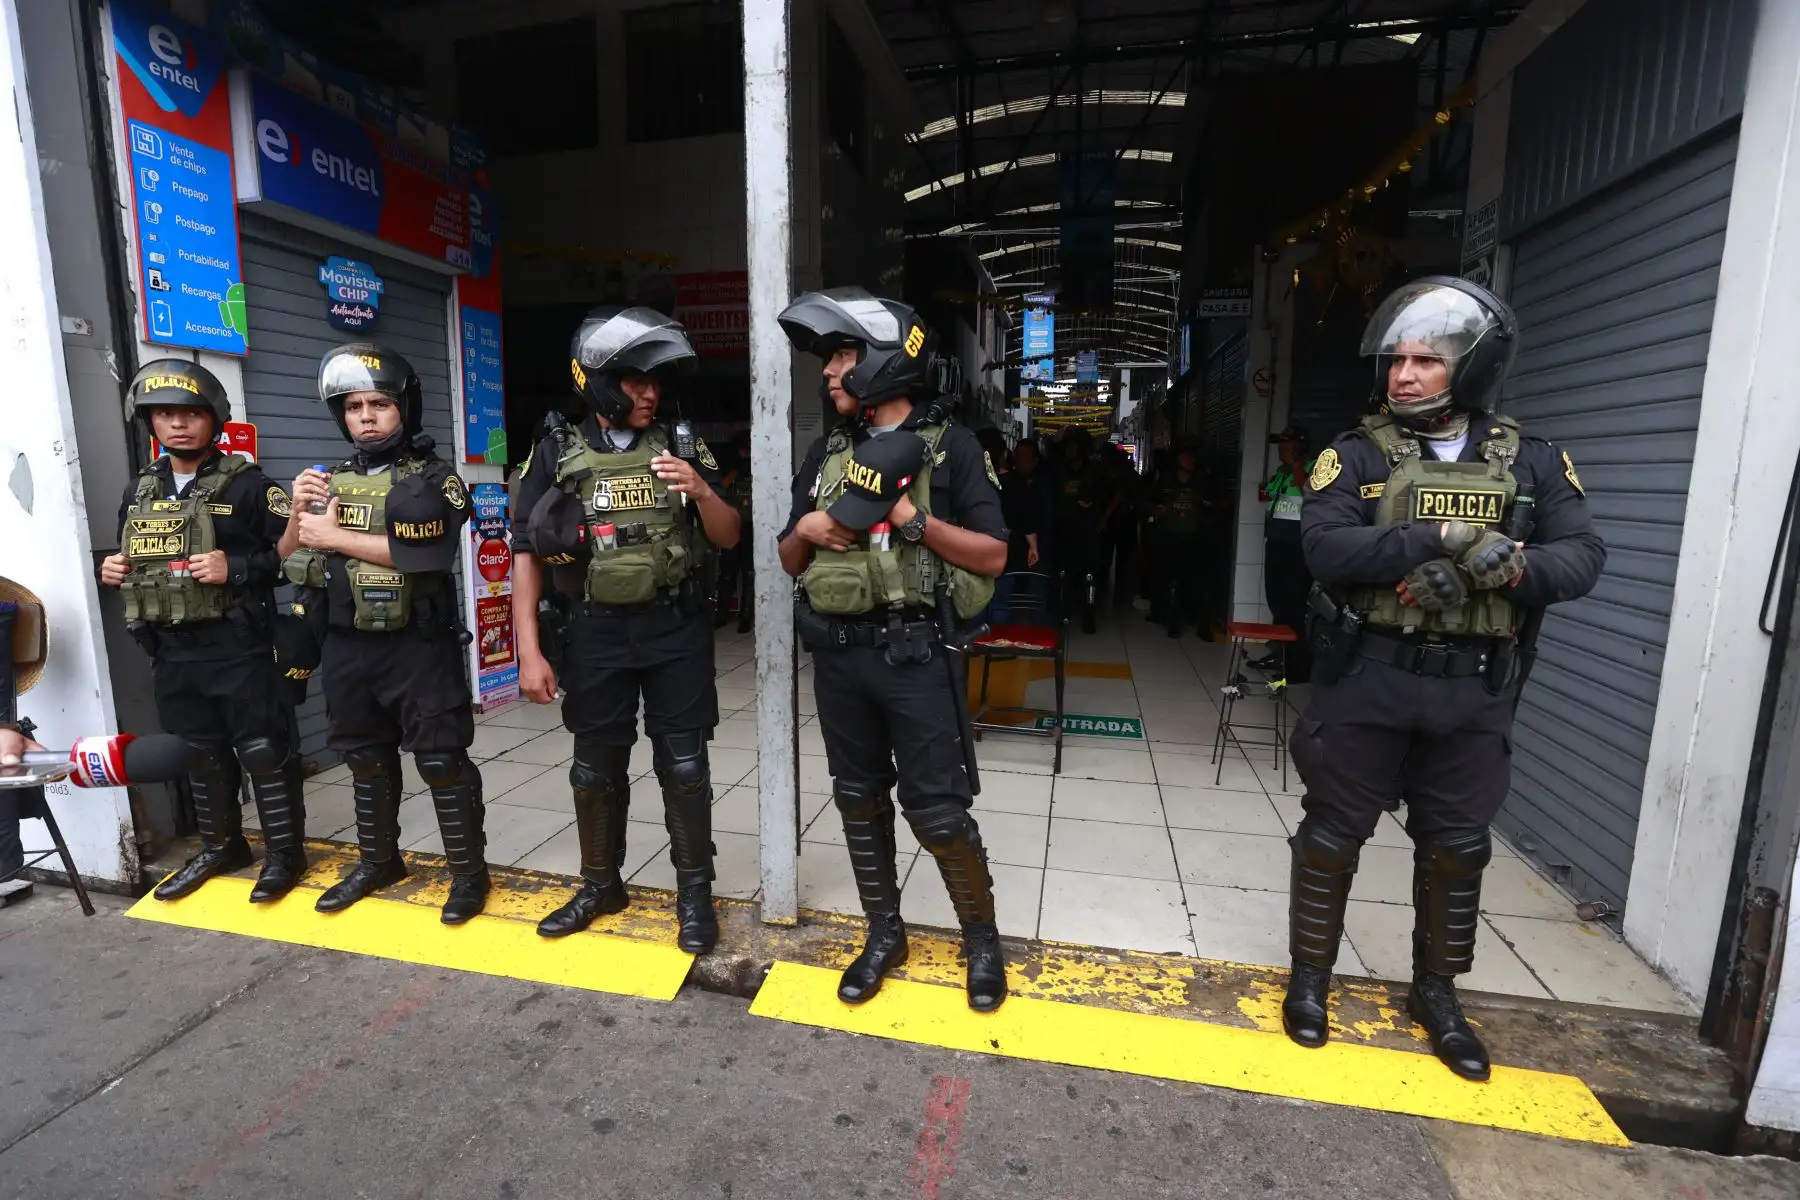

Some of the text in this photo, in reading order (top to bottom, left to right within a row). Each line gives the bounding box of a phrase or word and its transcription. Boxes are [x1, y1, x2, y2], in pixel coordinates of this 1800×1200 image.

[149, 61, 201, 93] entel
[169, 141, 194, 159] Venta
[170, 155, 207, 175] de chips
[312, 148, 379, 197] entel
[172, 181, 208, 202] Prepago
[175, 215, 216, 235] Postpago
[471, 228, 492, 247] ntel
[178, 249, 230, 270] Portabilidad
[321, 268, 381, 291] Movistar
[181, 283, 221, 301] Recargas
[338, 286, 369, 300] CHIP
[185, 320, 232, 338] Accesorios
[904, 325, 925, 358] GIR
[145, 375, 200, 395] POLICIA
[846, 459, 882, 495] LICIA
[611, 489, 652, 508] OLICIA
[1422, 493, 1497, 518] POLICIA
[481, 507, 499, 516] CHIP
[394, 520, 445, 539] POLICIA
[131, 537, 164, 555] POLICIA
[479, 550, 506, 566] Claro
